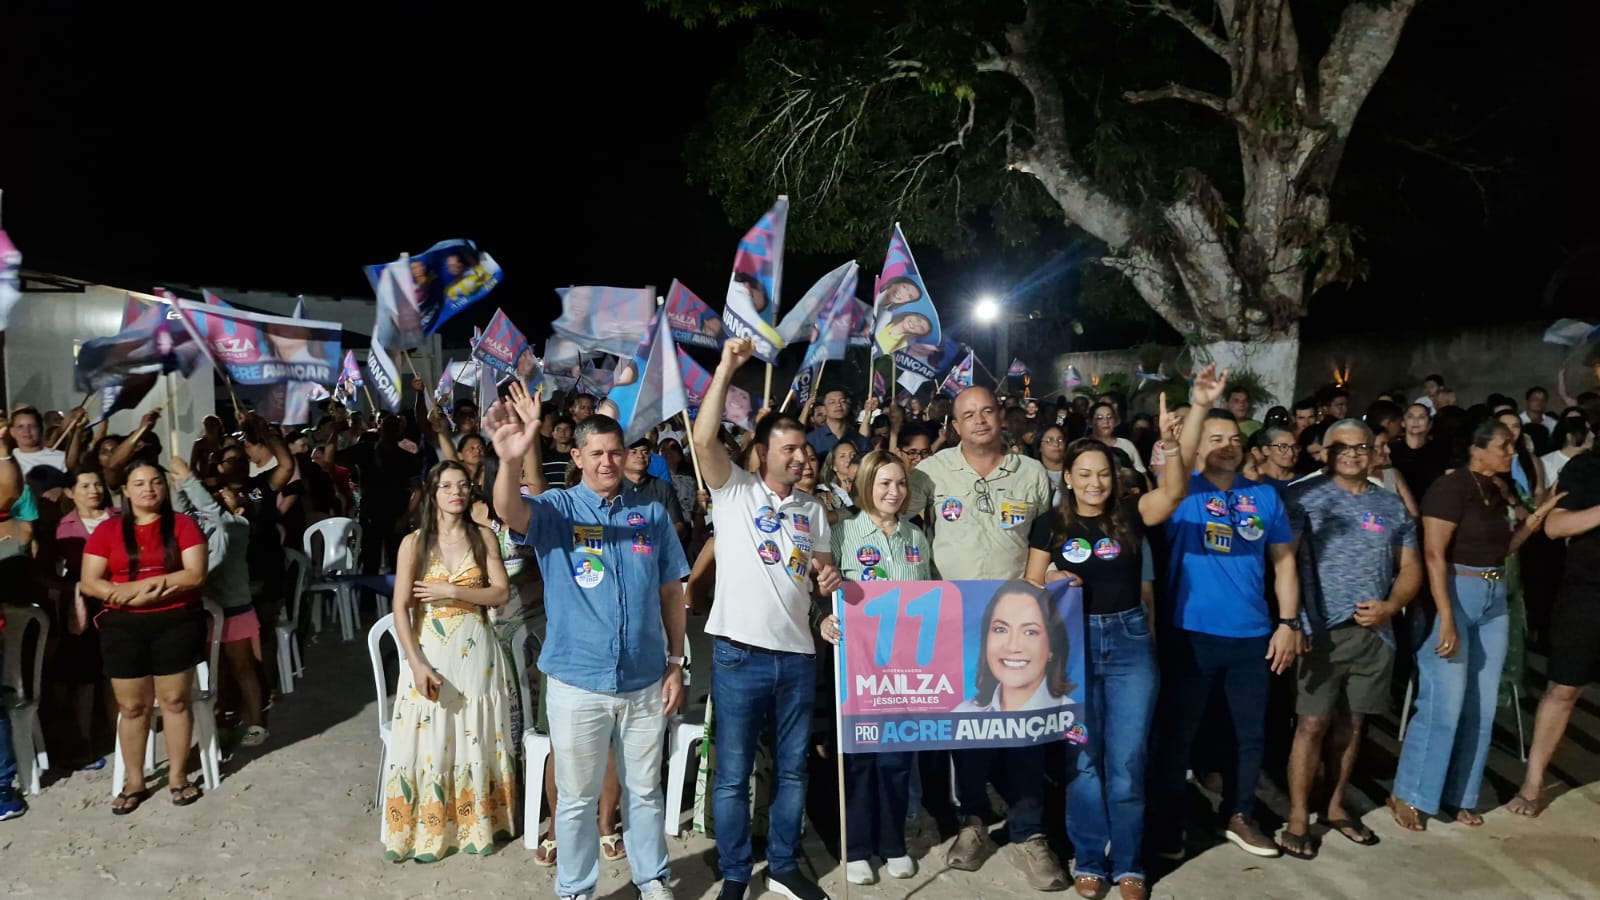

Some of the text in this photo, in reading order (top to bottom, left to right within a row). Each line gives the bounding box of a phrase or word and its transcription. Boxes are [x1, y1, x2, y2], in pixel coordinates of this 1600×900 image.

[864, 587, 943, 668] 11
[856, 673, 955, 696] MAILZA
[873, 696, 939, 707] JÉSSICA SALES
[855, 725, 879, 742] PRO
[881, 719, 953, 744] ACRE
[955, 710, 1075, 742] AVANÇAR
